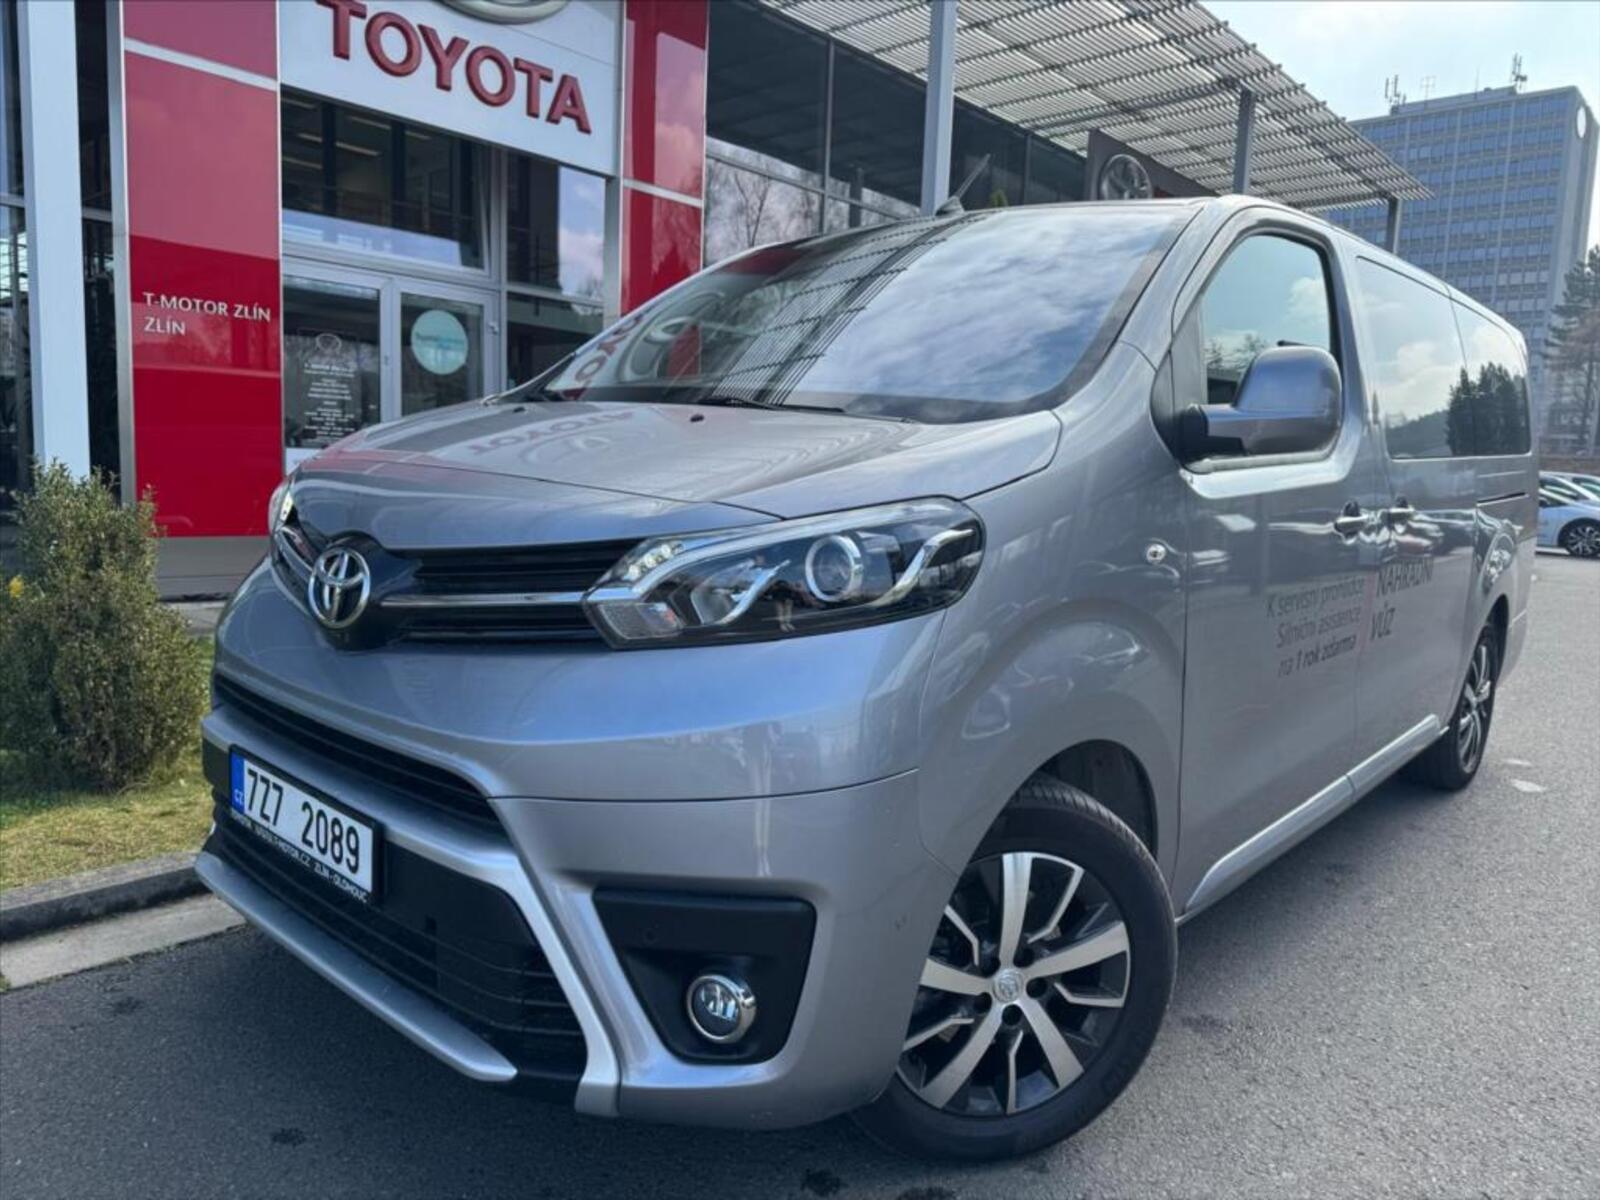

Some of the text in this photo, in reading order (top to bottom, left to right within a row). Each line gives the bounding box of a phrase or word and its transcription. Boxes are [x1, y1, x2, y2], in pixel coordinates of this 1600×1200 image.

[314, 0, 592, 135] TOYOTA
[142, 291, 271, 322] T-MOTOR ZLÍN
[143, 315, 186, 336] ZLÍN
[247, 767, 360, 875] 7Z7 2089
